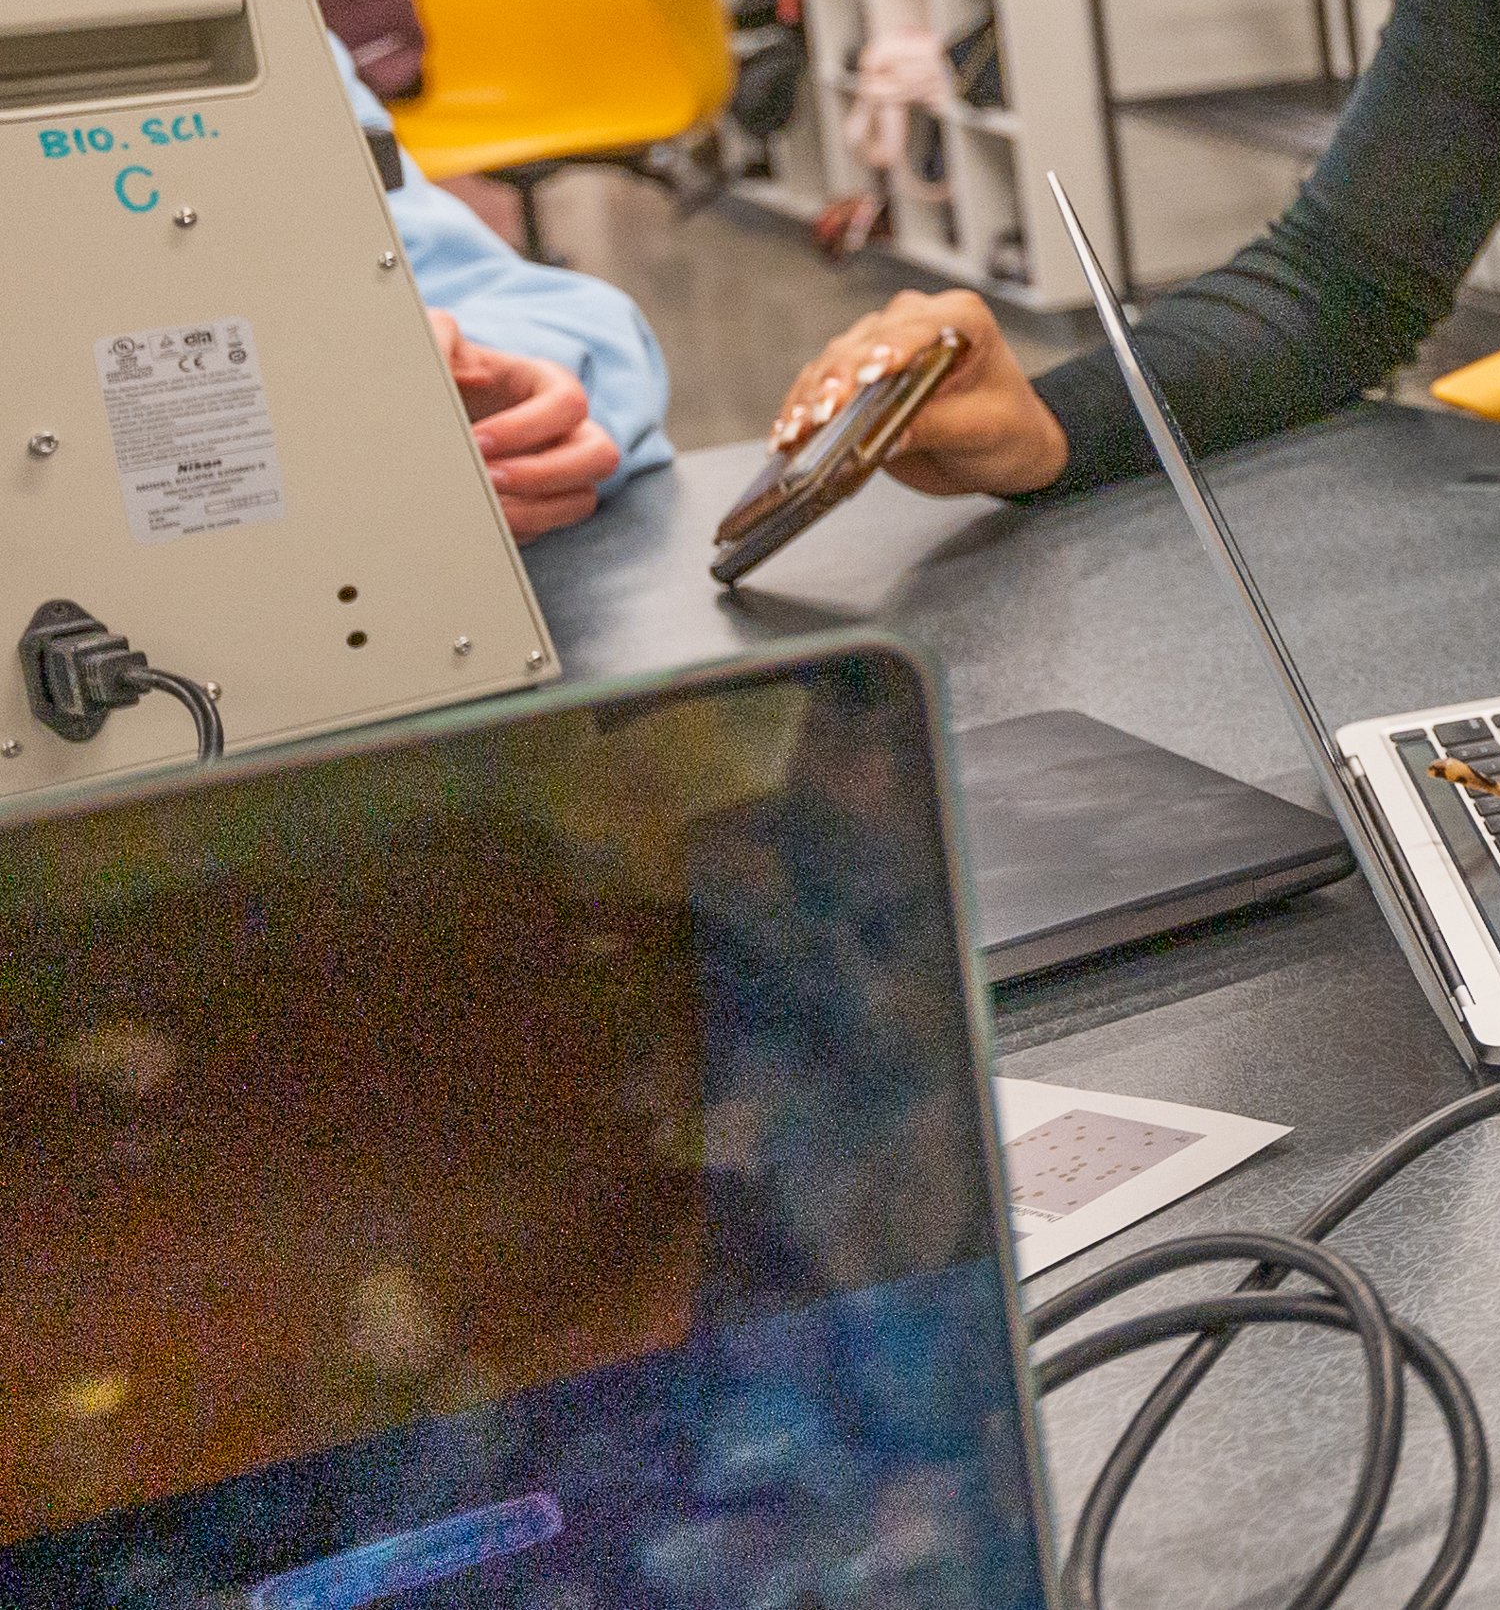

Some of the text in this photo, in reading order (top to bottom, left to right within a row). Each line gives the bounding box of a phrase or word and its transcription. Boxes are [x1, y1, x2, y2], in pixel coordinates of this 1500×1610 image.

[38, 112, 221, 159] BIO. SCI.
[114, 164, 161, 214] C
